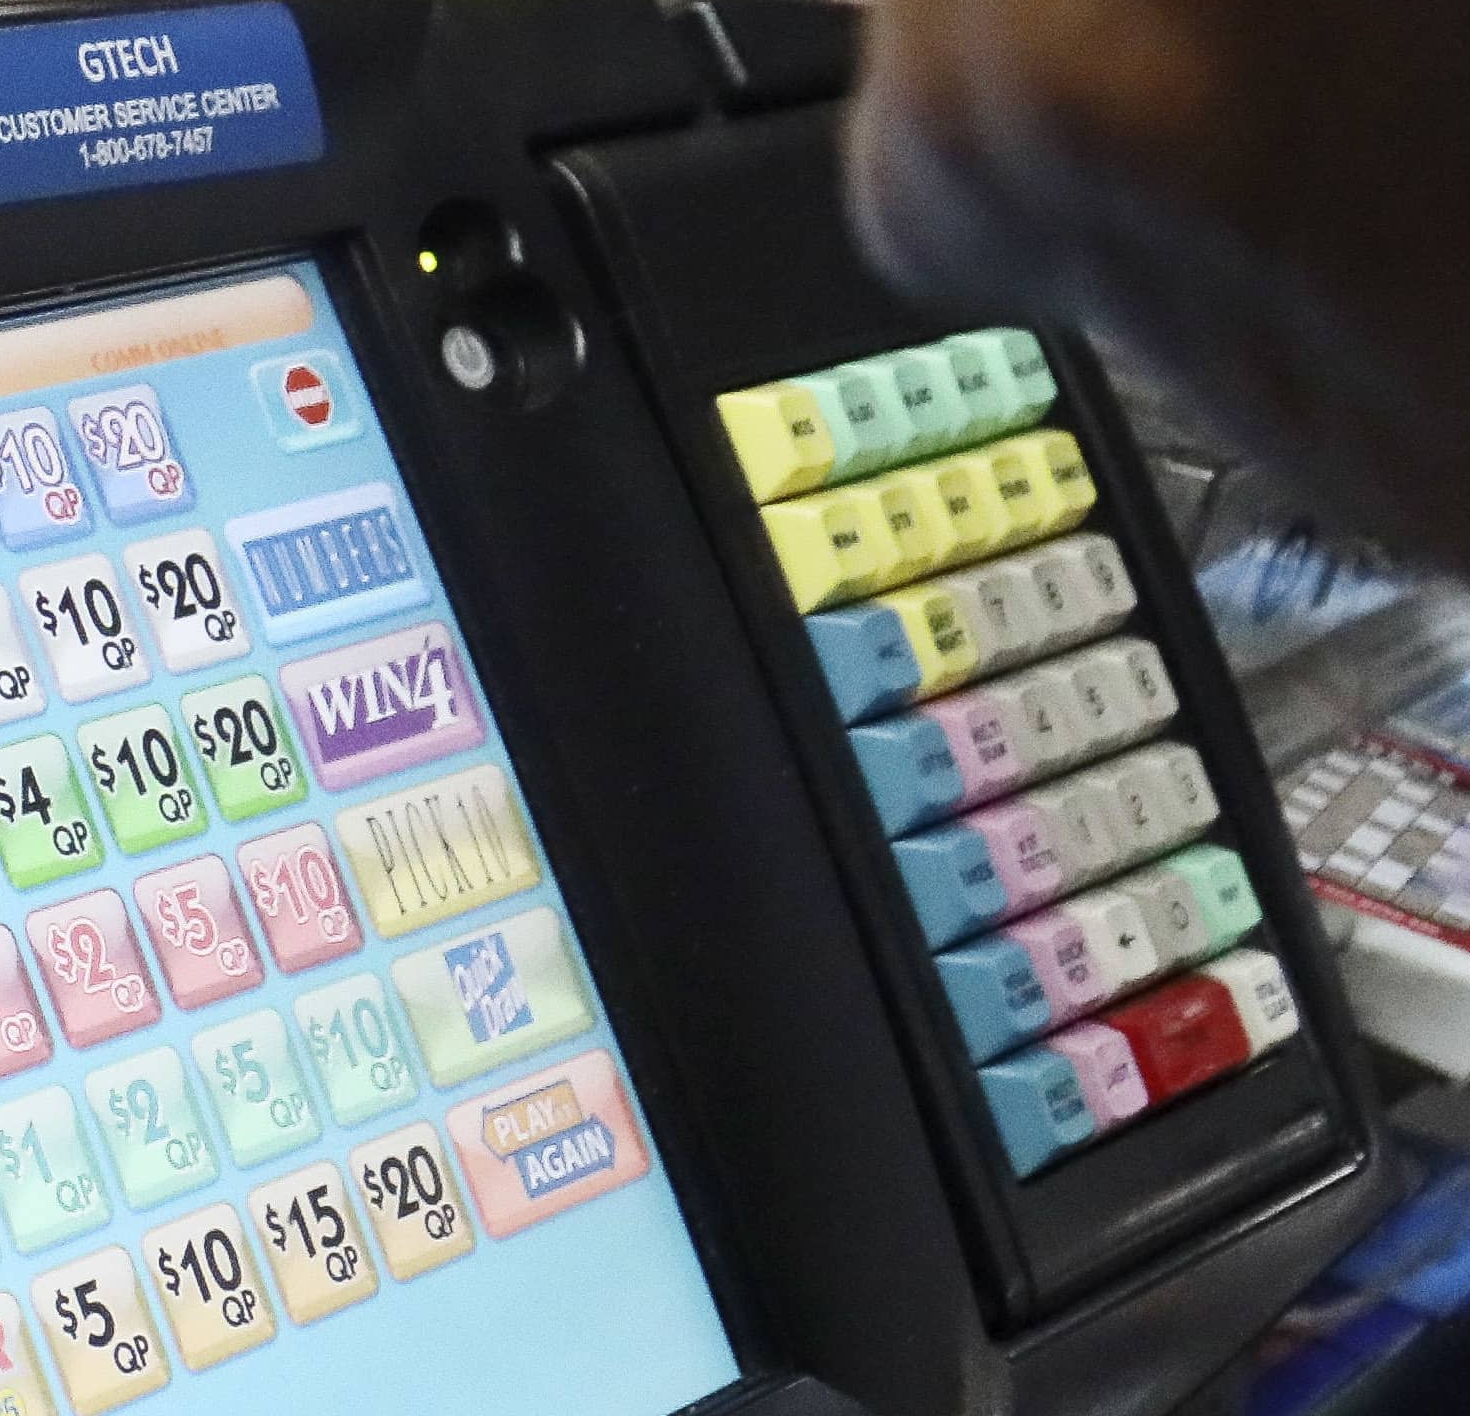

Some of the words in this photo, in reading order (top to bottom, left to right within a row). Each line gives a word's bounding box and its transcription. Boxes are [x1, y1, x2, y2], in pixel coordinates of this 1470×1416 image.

[78, 35, 179, 82] GTECH
[113, 93, 200, 127] SERVICE
[202, 83, 281, 114] CENTER
[84, 400, 166, 469] $20
[44, 488, 80, 524] QP
[141, 552, 221, 620] $20
[35, 579, 122, 646] $10
[204, 608, 237, 643] QP
[101, 637, 137, 673] QP
[194, 699, 278, 766] $20
[91, 728, 178, 796] $10
[260, 757, 293, 792] QP
[159, 789, 192, 824] QP
[52, 820, 88, 857] QP
[249, 845, 342, 924] $10
[308, 997, 388, 1069] $10
[214, 1039, 271, 1105] $5
[107, 1078, 173, 1145] $2
[269, 1092, 306, 1129] QP
[493, 1101, 554, 1147] PLAY
[165, 1132, 203, 1171] QP
[524, 1124, 614, 1189] AGAIN
[55, 1174, 93, 1213] QP
[364, 1145, 444, 1220] $20
[265, 1184, 346, 1258] $15
[424, 1204, 456, 1241] QP
[158, 1228, 242, 1303] $10
[325, 1246, 359, 1285] QP
[55, 1279, 115, 1348] $5
[222, 1290, 257, 1328] QP
[113, 1335, 150, 1375] QP
